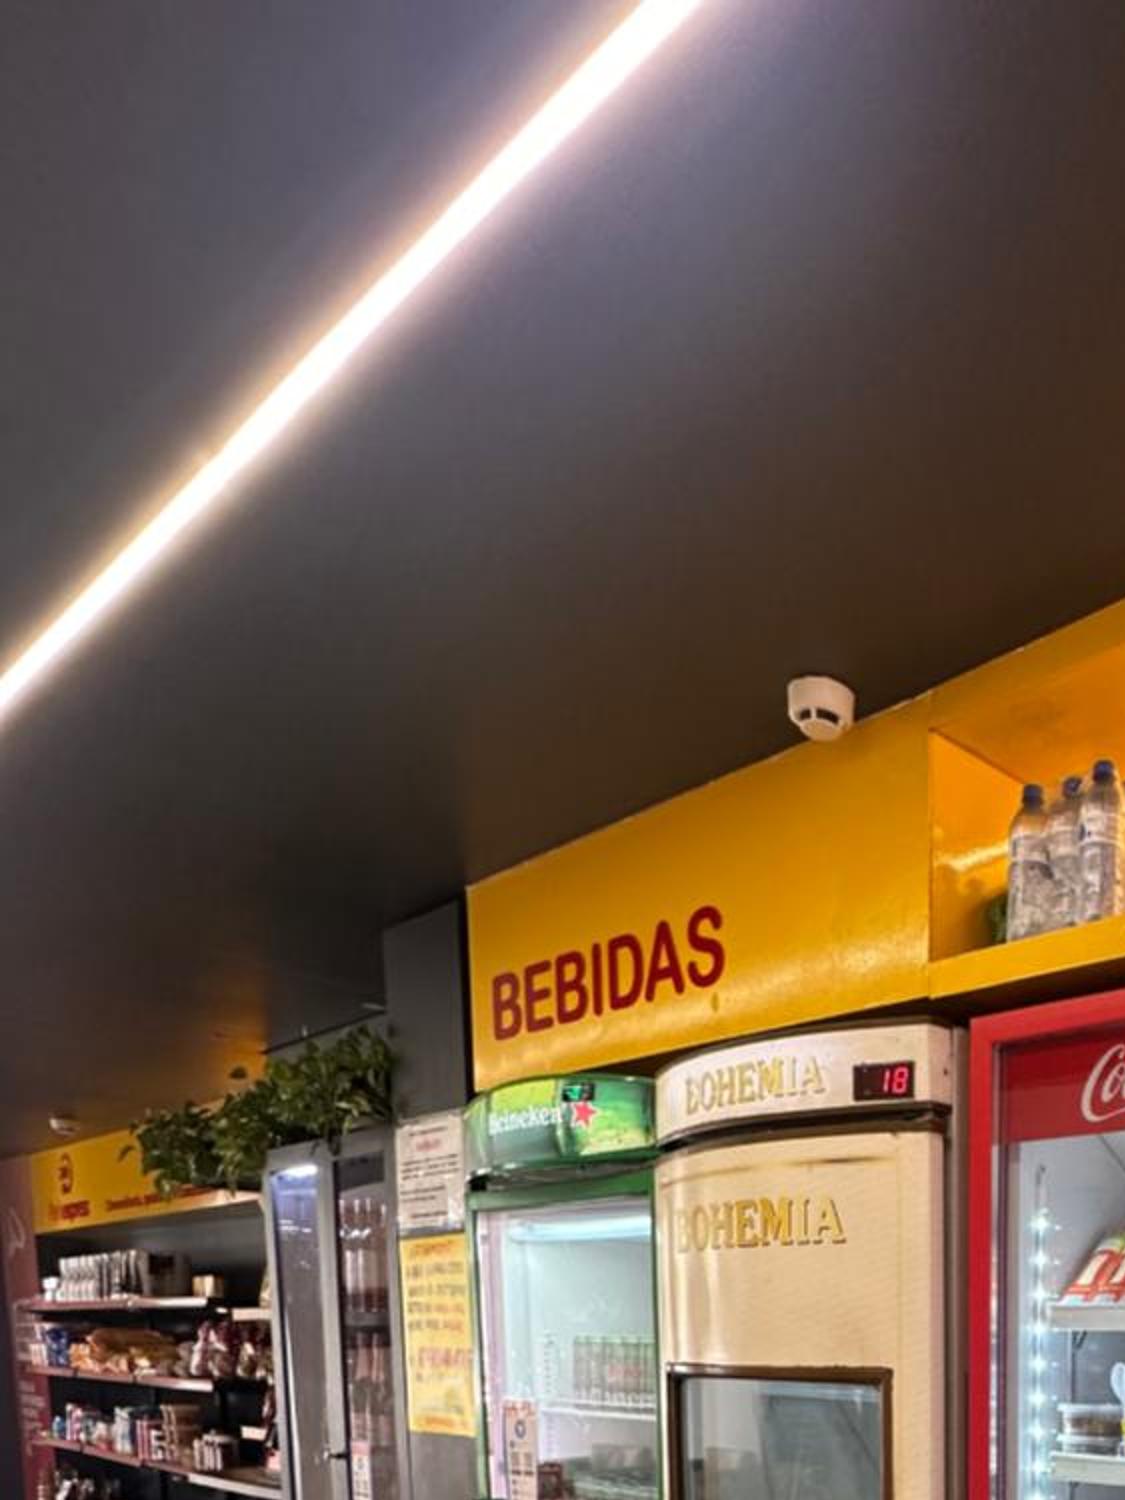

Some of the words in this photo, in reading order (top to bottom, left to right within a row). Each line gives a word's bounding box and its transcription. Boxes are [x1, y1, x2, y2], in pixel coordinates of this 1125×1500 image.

[492, 905, 725, 1041] BEBIDAS
[686, 1056, 827, 1114] BOHEMIA
[880, 1066, 909, 1095] 18
[675, 1197, 847, 1253] BOHEMIA
